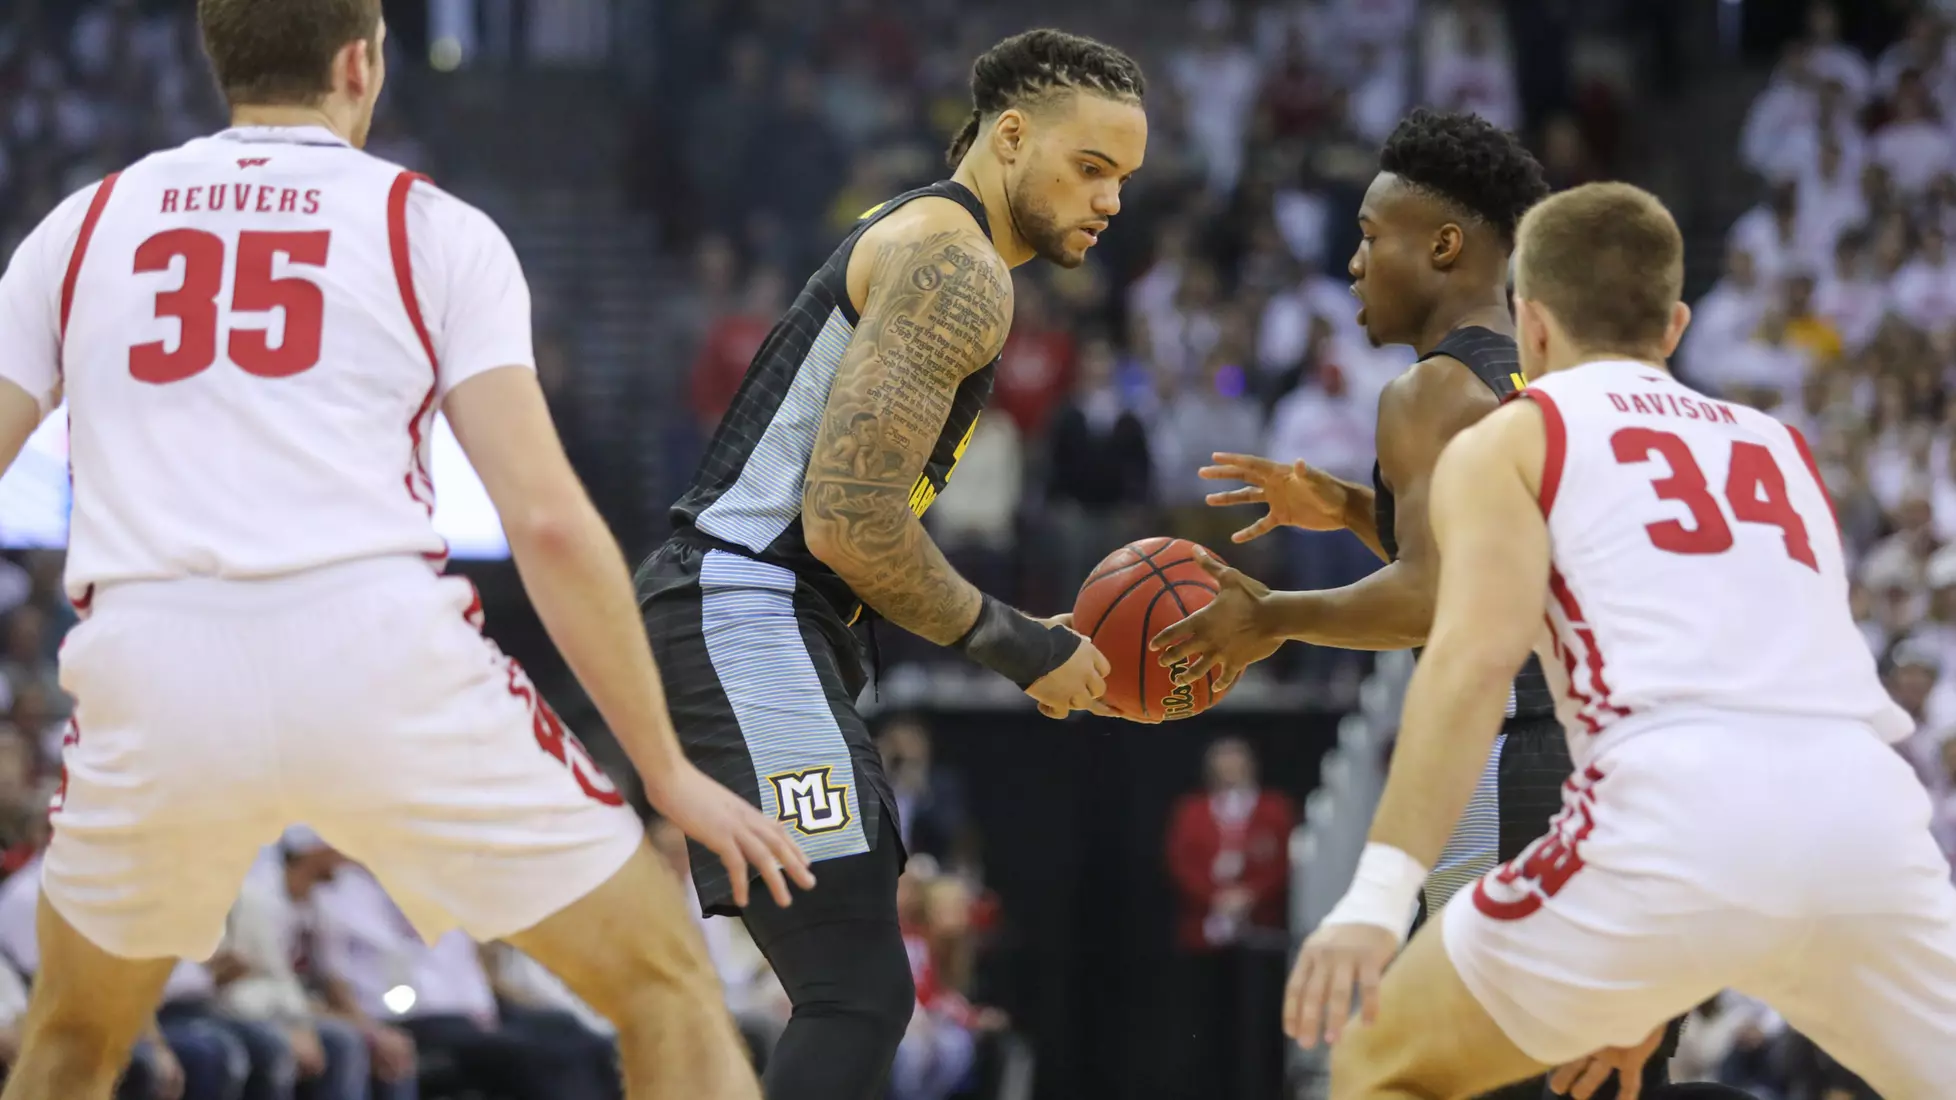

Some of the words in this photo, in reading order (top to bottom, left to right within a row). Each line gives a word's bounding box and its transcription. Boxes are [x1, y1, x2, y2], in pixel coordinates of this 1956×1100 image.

[160, 183, 322, 214] REUVERS
[128, 227, 332, 385] 35
[1607, 392, 1738, 425] DAVISON
[1609, 427, 1821, 574] 34
[768, 767, 851, 835] MU
